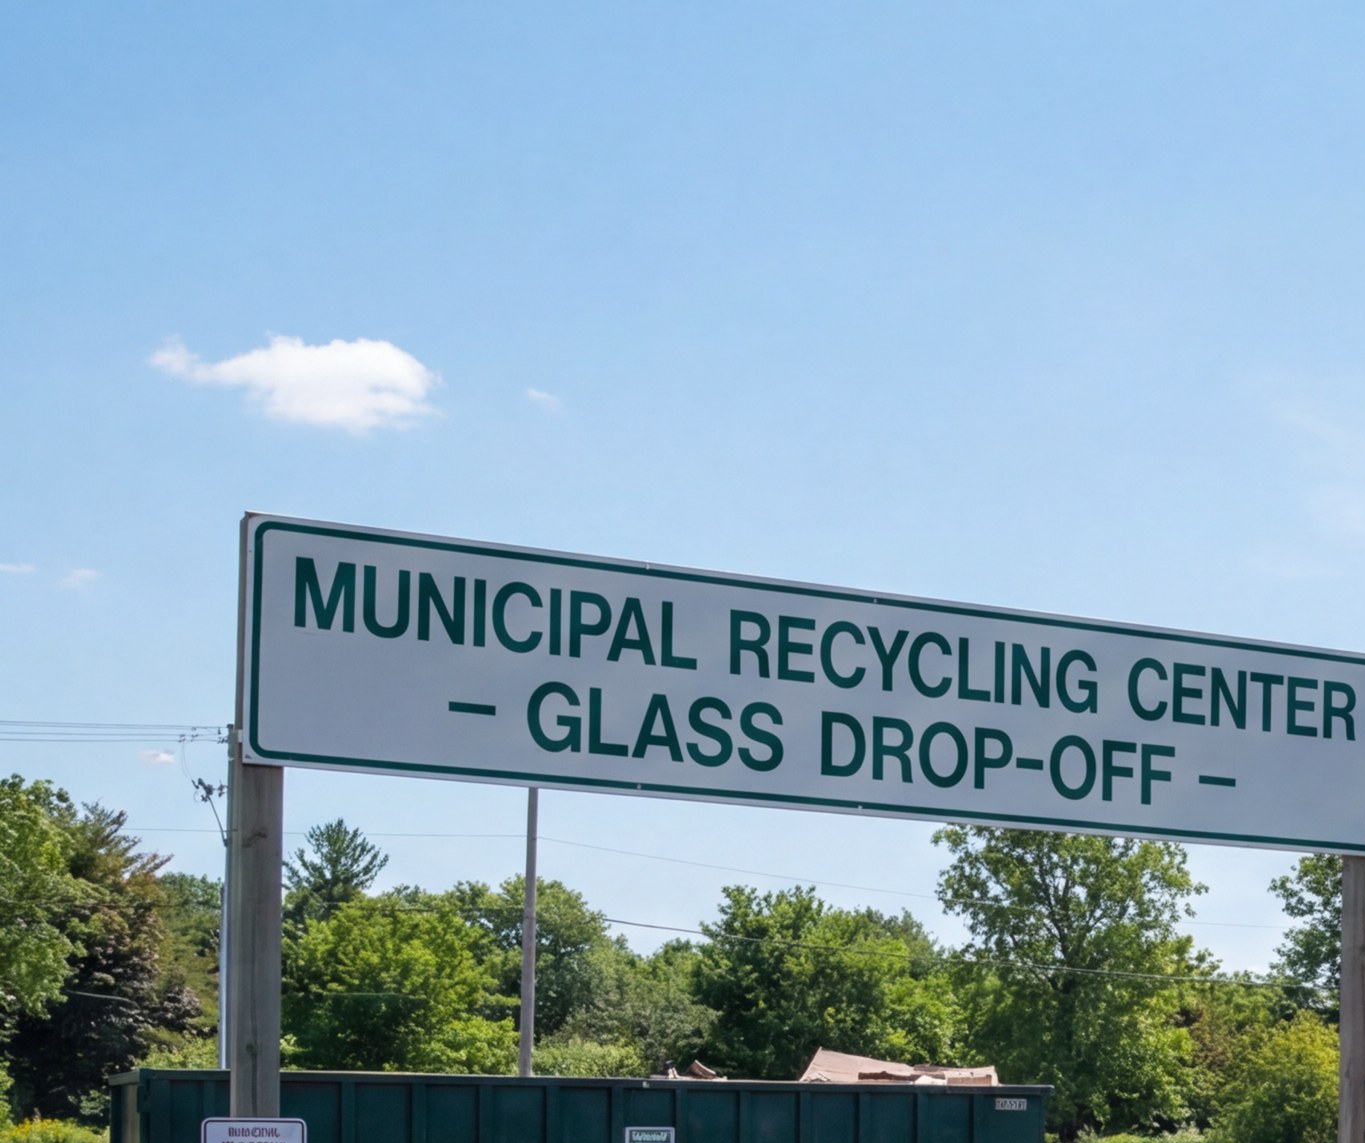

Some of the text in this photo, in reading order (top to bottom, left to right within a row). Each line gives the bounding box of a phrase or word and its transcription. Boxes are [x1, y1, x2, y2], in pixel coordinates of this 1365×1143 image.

[293, 555, 1357, 742] MUNICIPAL RECYCLING CENTER
[526, 680, 785, 773] GLASS
[820, 710, 1176, 806] DROP-OFF
